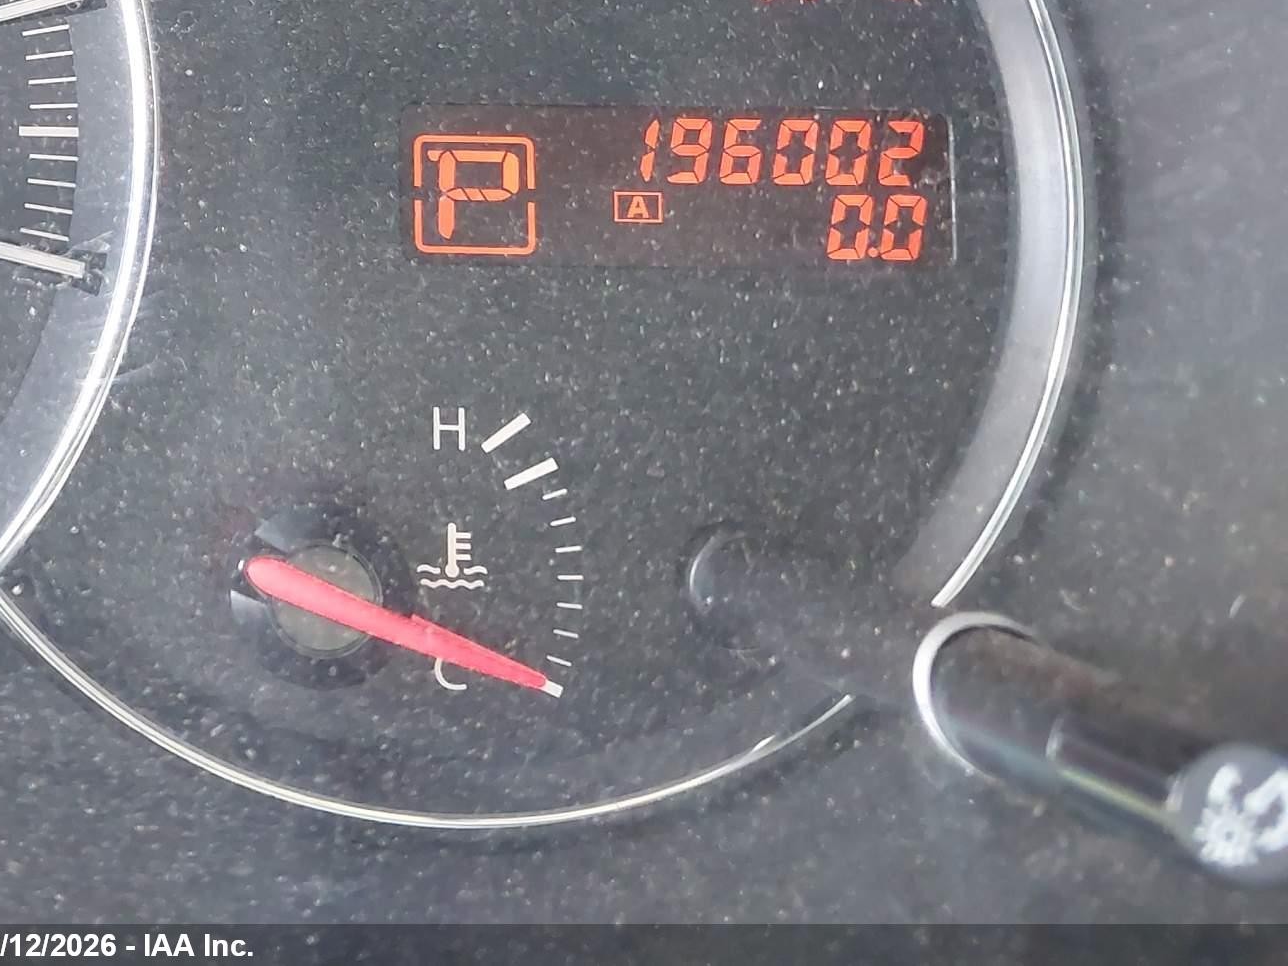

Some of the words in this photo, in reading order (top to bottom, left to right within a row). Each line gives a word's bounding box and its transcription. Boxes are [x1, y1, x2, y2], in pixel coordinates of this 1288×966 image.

[639, 117, 924, 186] 196002
[427, 150, 520, 239] P
[826, 194, 926, 261] 0.0
[432, 406, 466, 451] H
